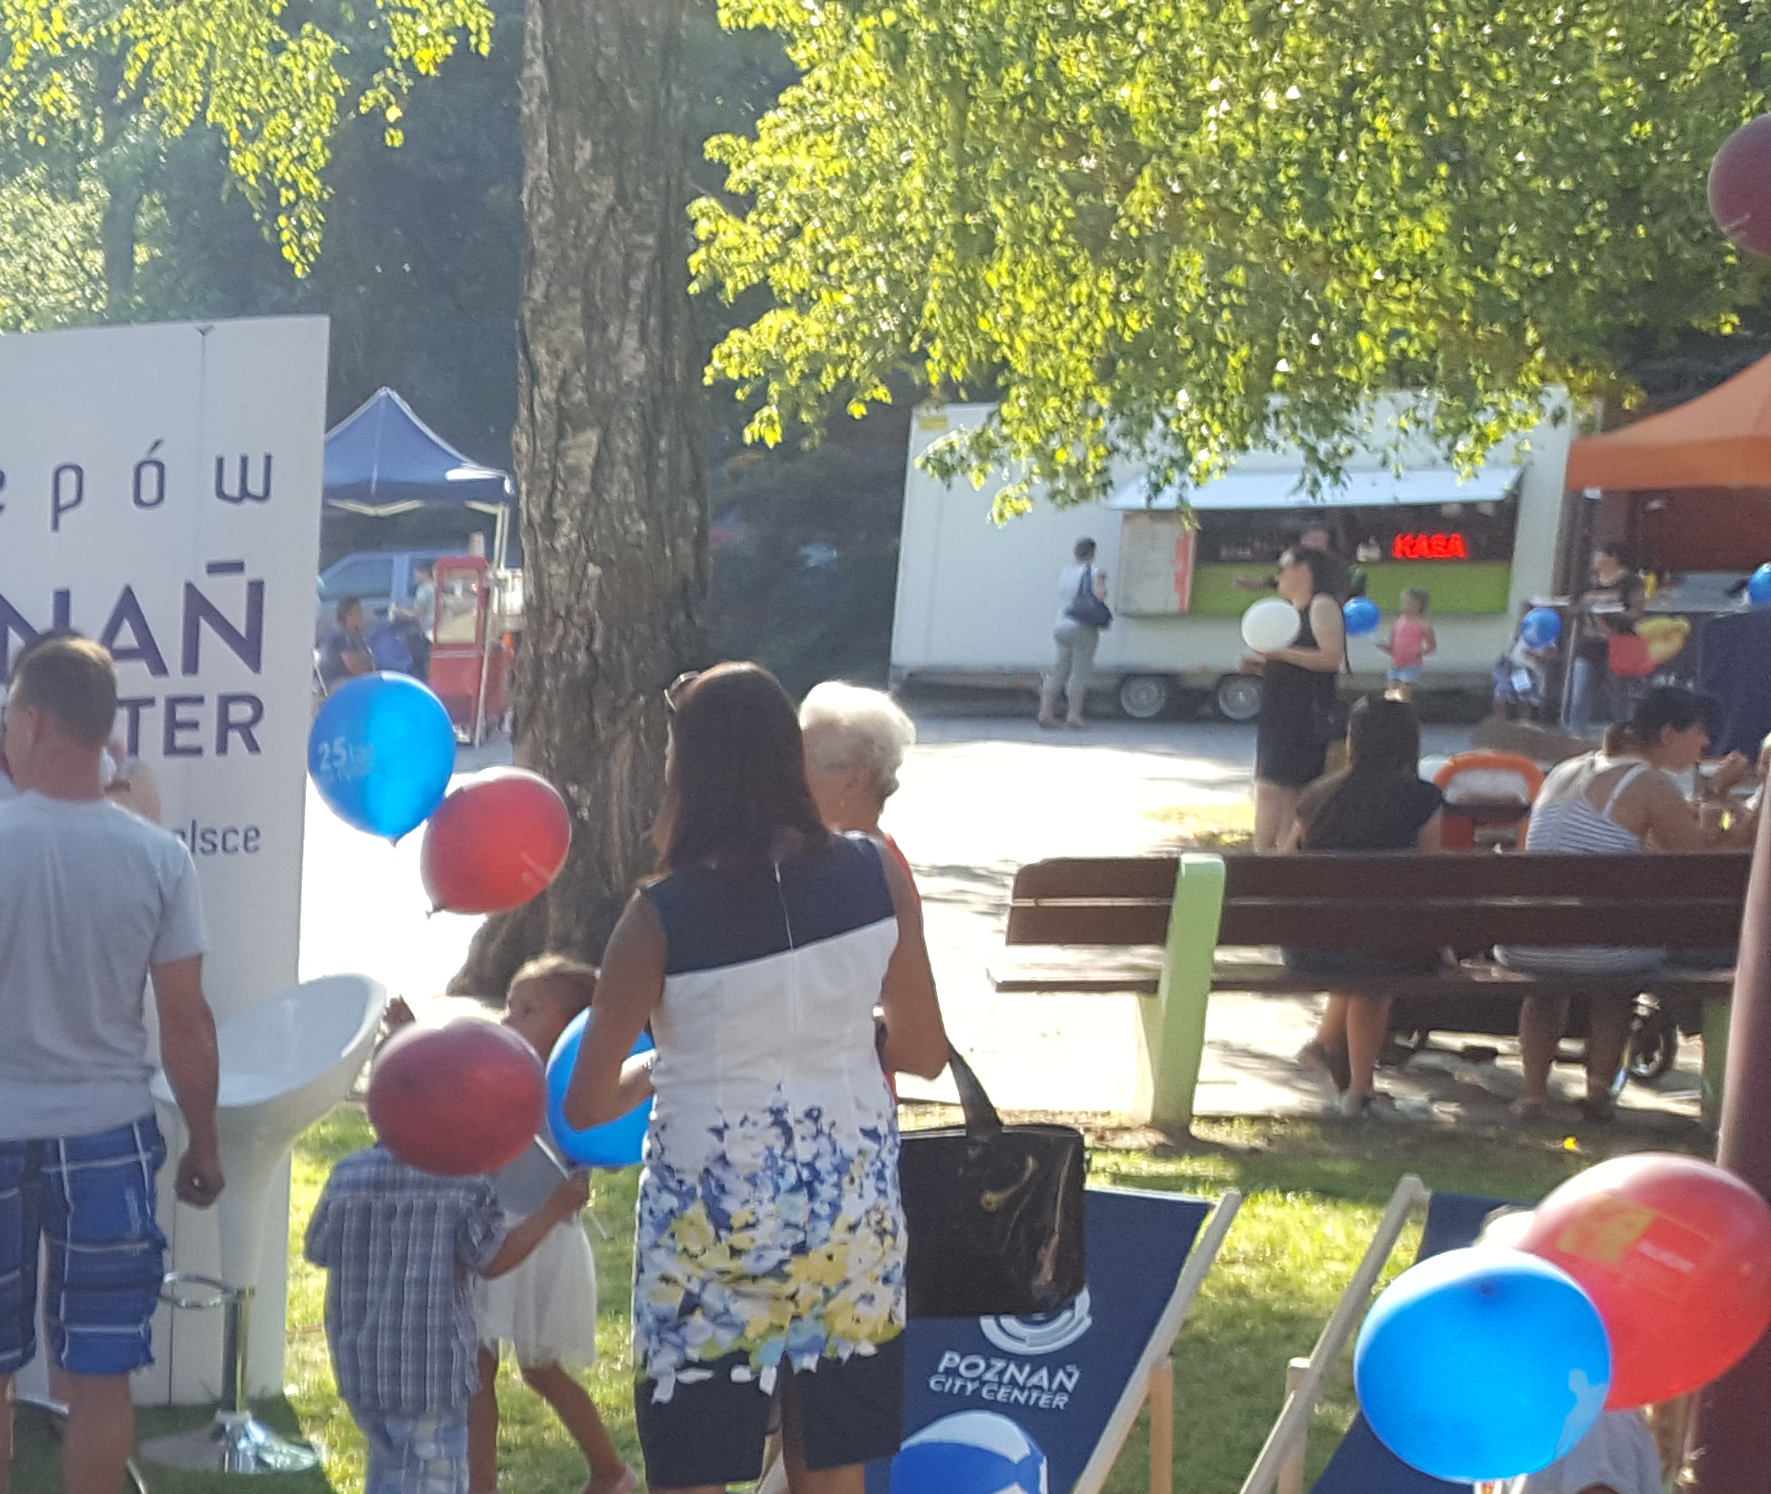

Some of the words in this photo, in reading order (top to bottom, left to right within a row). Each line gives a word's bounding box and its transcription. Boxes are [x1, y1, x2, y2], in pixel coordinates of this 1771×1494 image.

[928, 1373, 981, 1397] CITY
[981, 1382, 1071, 1411] CENTER
[937, 1349, 1083, 1394] POZNAŃ
